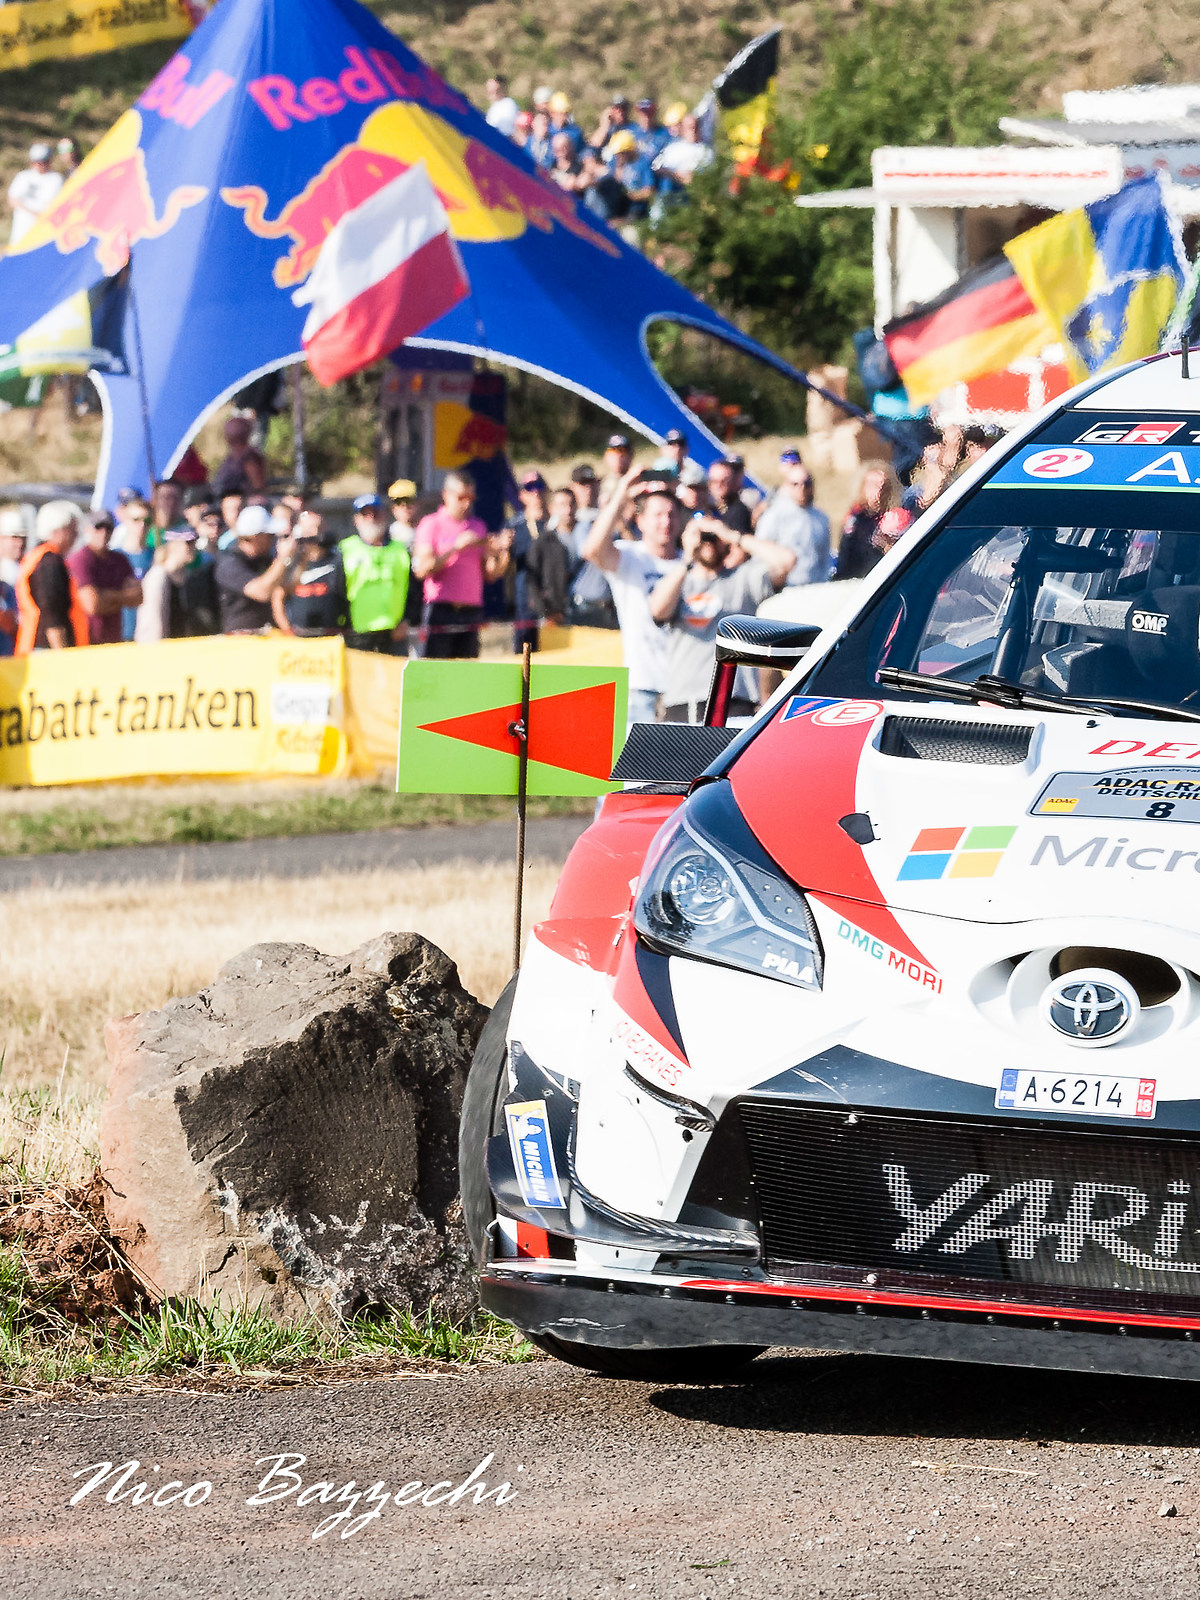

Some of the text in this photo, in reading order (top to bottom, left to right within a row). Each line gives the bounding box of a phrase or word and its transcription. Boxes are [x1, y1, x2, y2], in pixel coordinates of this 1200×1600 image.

[247, 45, 390, 131] Red
[1132, 613, 1168, 632] OMP
[1092, 777, 1168, 791] ADAC
[1047, 797, 1078, 805] ADAC
[1144, 801, 1176, 819] 8
[837, 919, 943, 995] DMG MORI
[761, 952, 815, 984] PIAA
[1138, 1081, 1155, 1096] 12
[1136, 1098, 1152, 1113] 18
